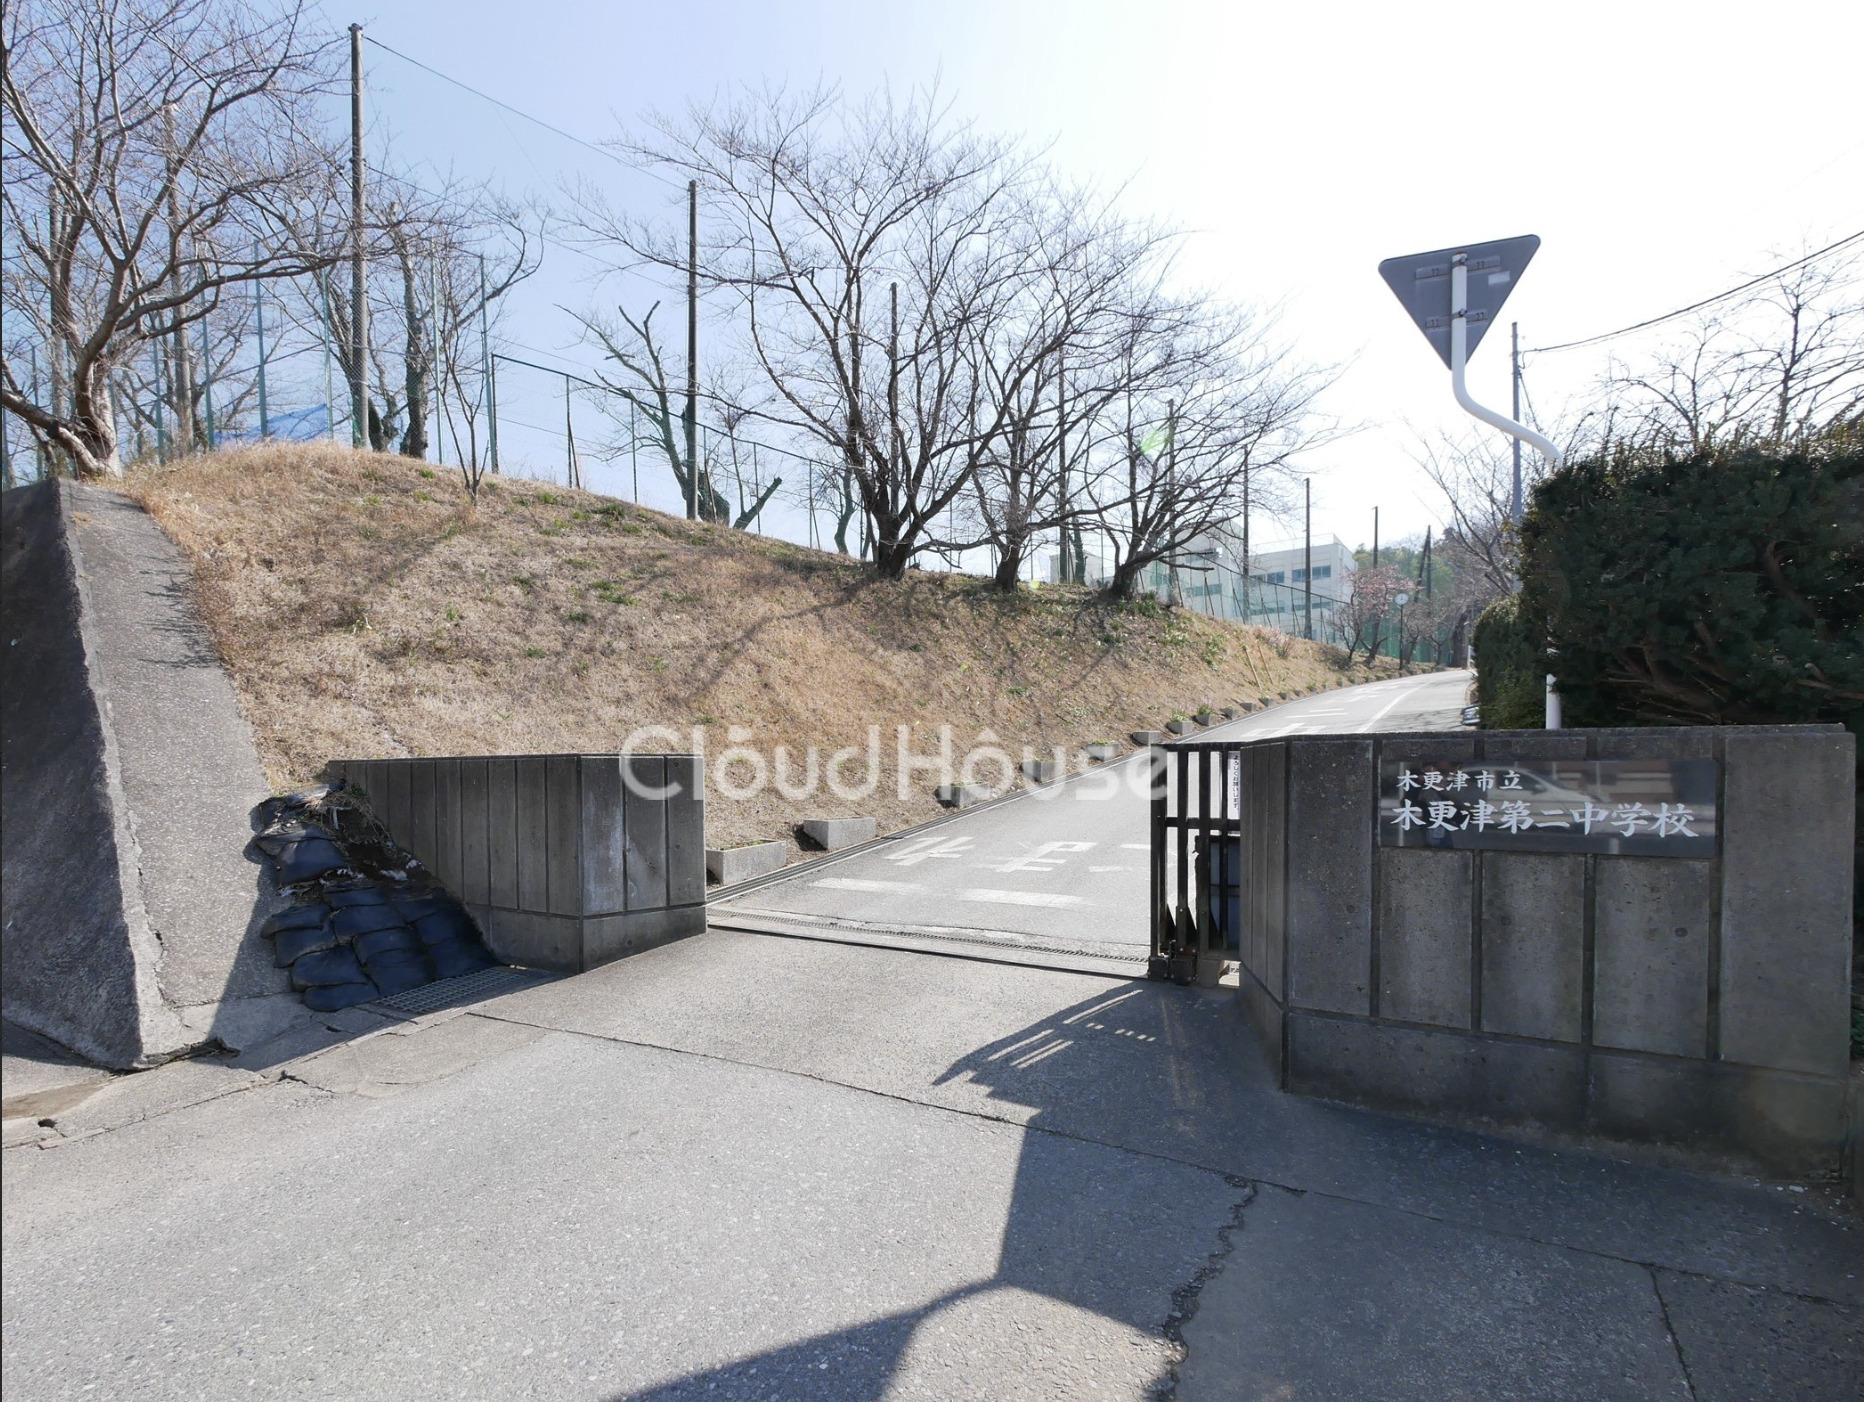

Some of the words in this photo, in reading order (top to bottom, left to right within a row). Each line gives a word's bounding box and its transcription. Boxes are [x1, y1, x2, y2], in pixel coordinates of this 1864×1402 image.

[1396, 770, 1523, 792] 木更津市立
[1391, 799, 1699, 838] 木更津第二中学校
